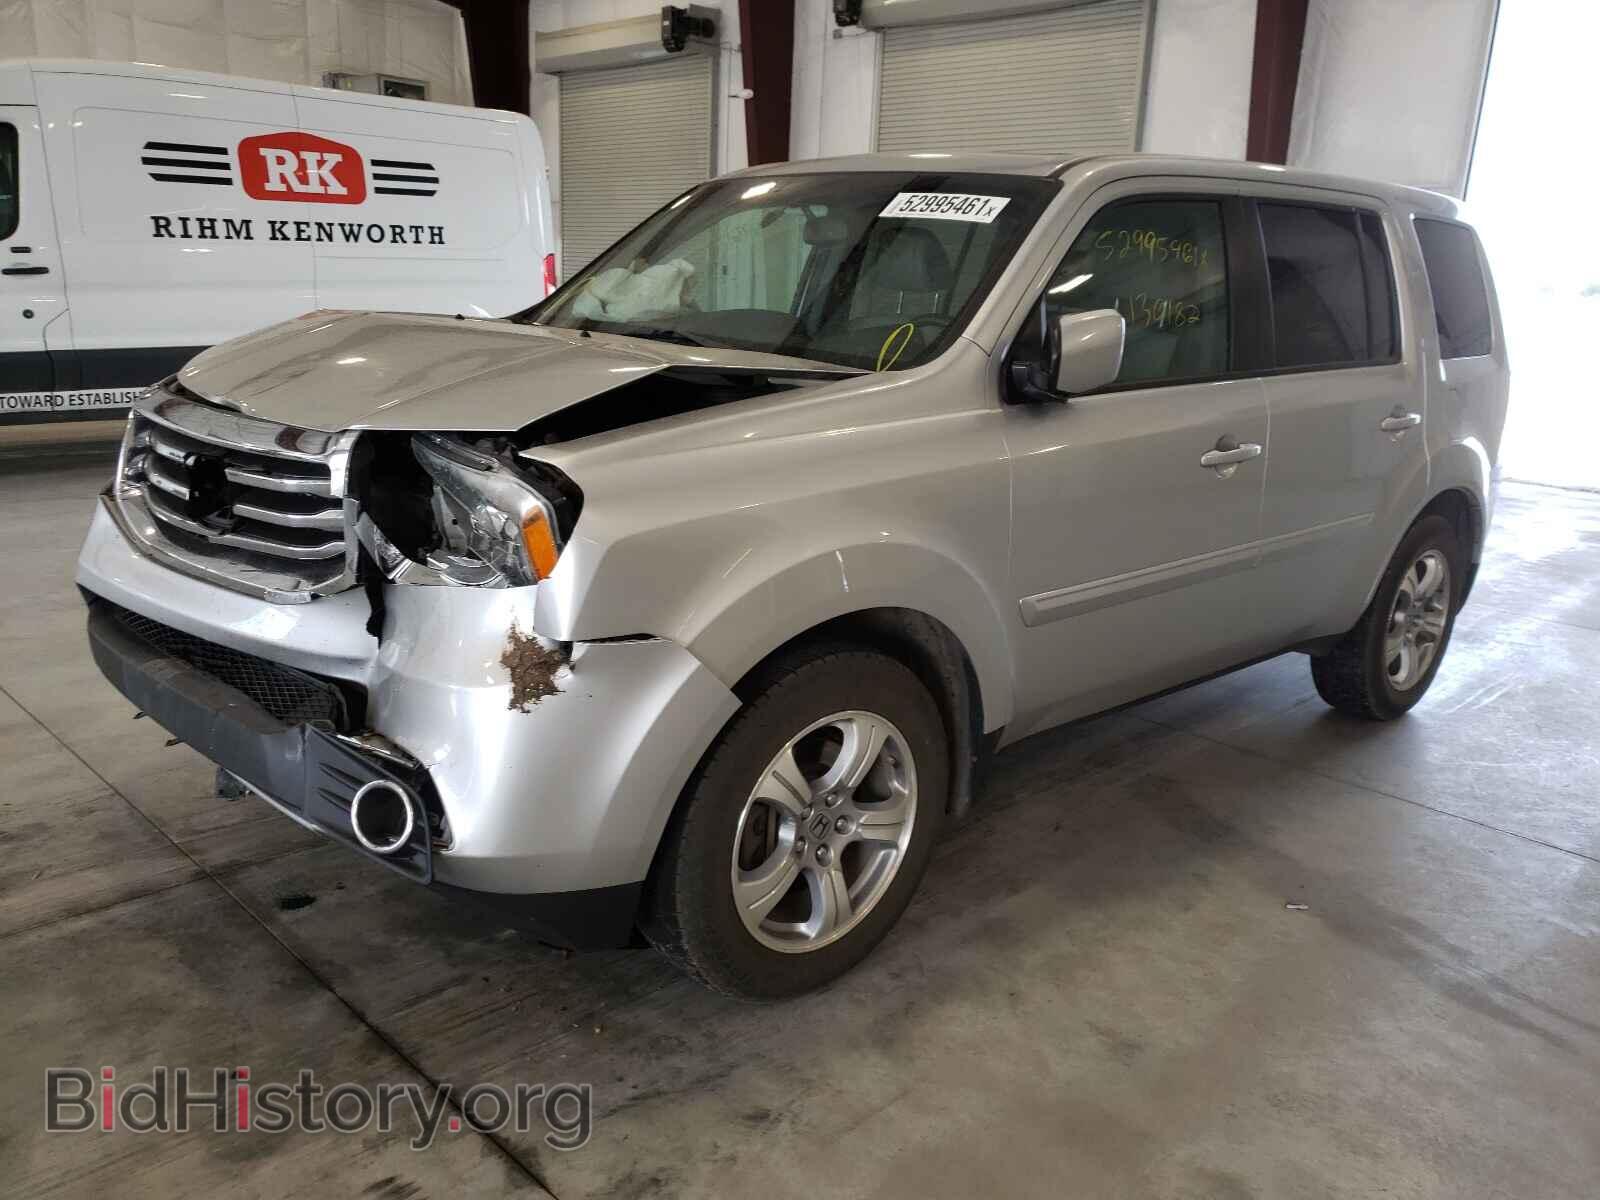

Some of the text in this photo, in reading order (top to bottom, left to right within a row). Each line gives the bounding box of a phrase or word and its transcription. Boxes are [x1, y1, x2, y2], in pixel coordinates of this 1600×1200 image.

[260, 147, 348, 196] RK
[151, 215, 446, 246] RIHM KENWORTH
